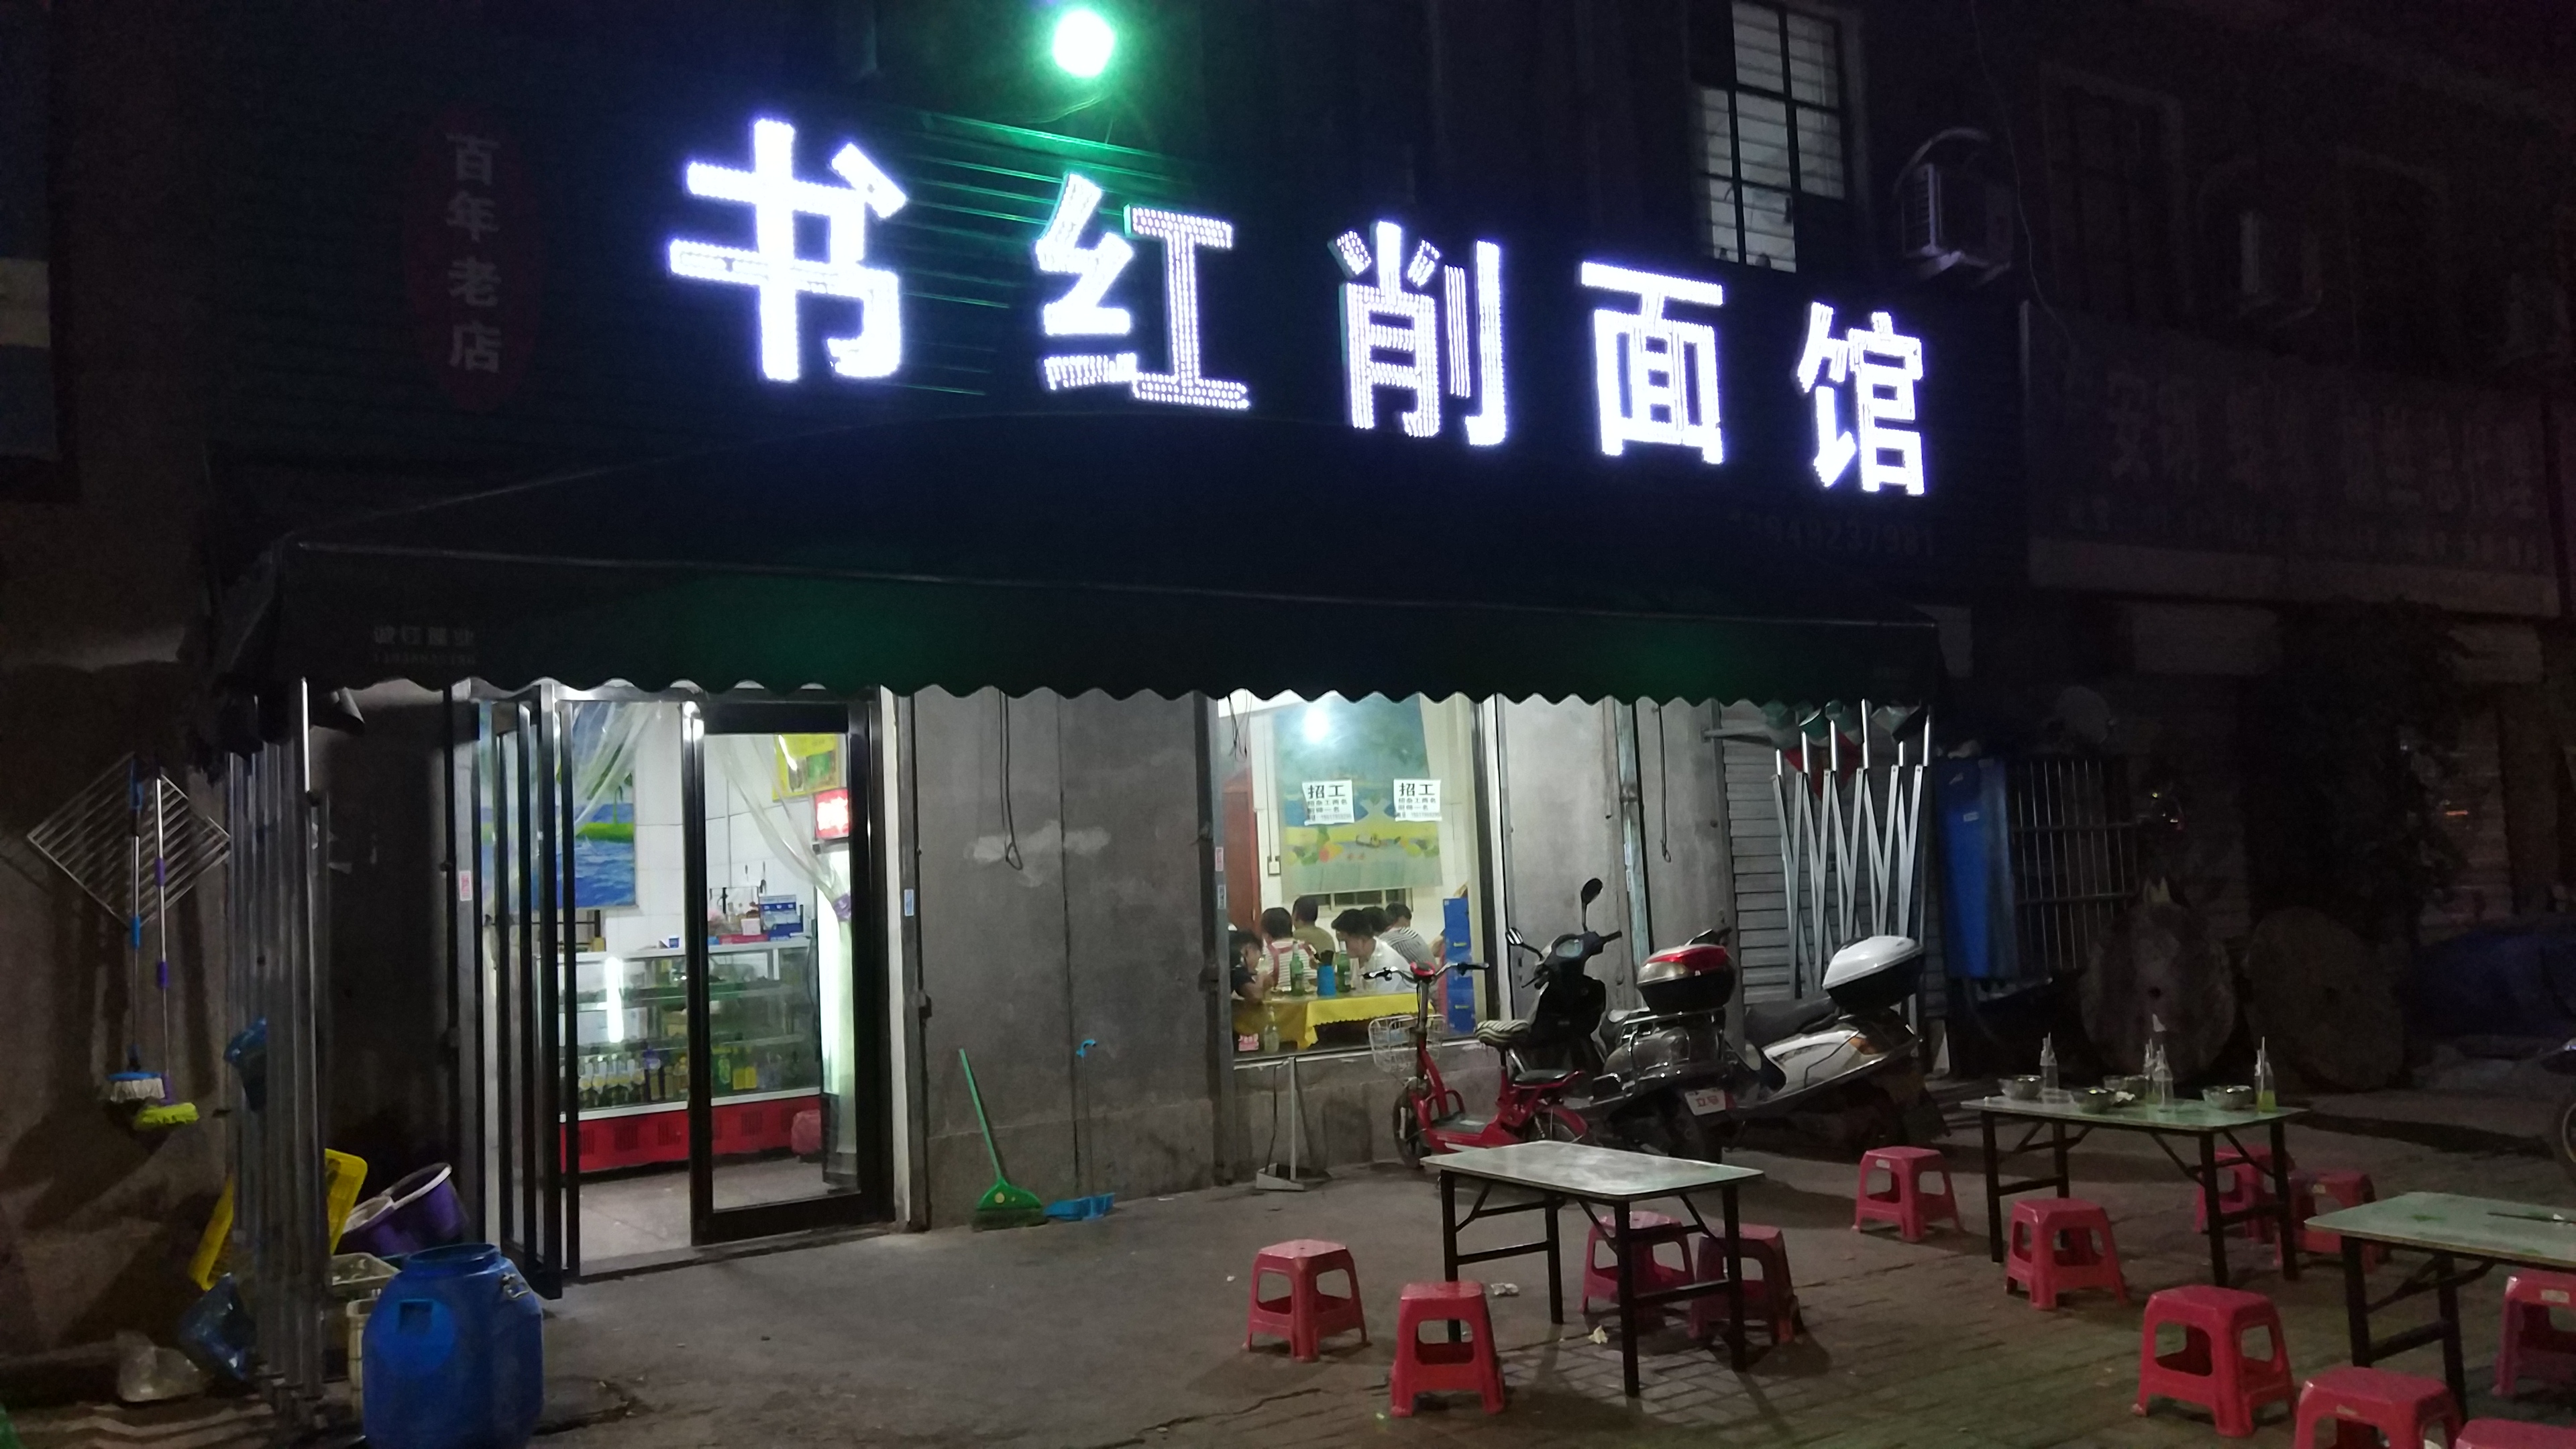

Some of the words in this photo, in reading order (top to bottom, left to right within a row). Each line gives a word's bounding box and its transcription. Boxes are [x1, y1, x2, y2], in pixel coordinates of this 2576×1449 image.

[445, 132, 502, 374] 百年老店
[667, 117, 1927, 497] 书红削面馆
[1307, 784, 1346, 799] 招工
[1399, 782, 1435, 797] 招工
